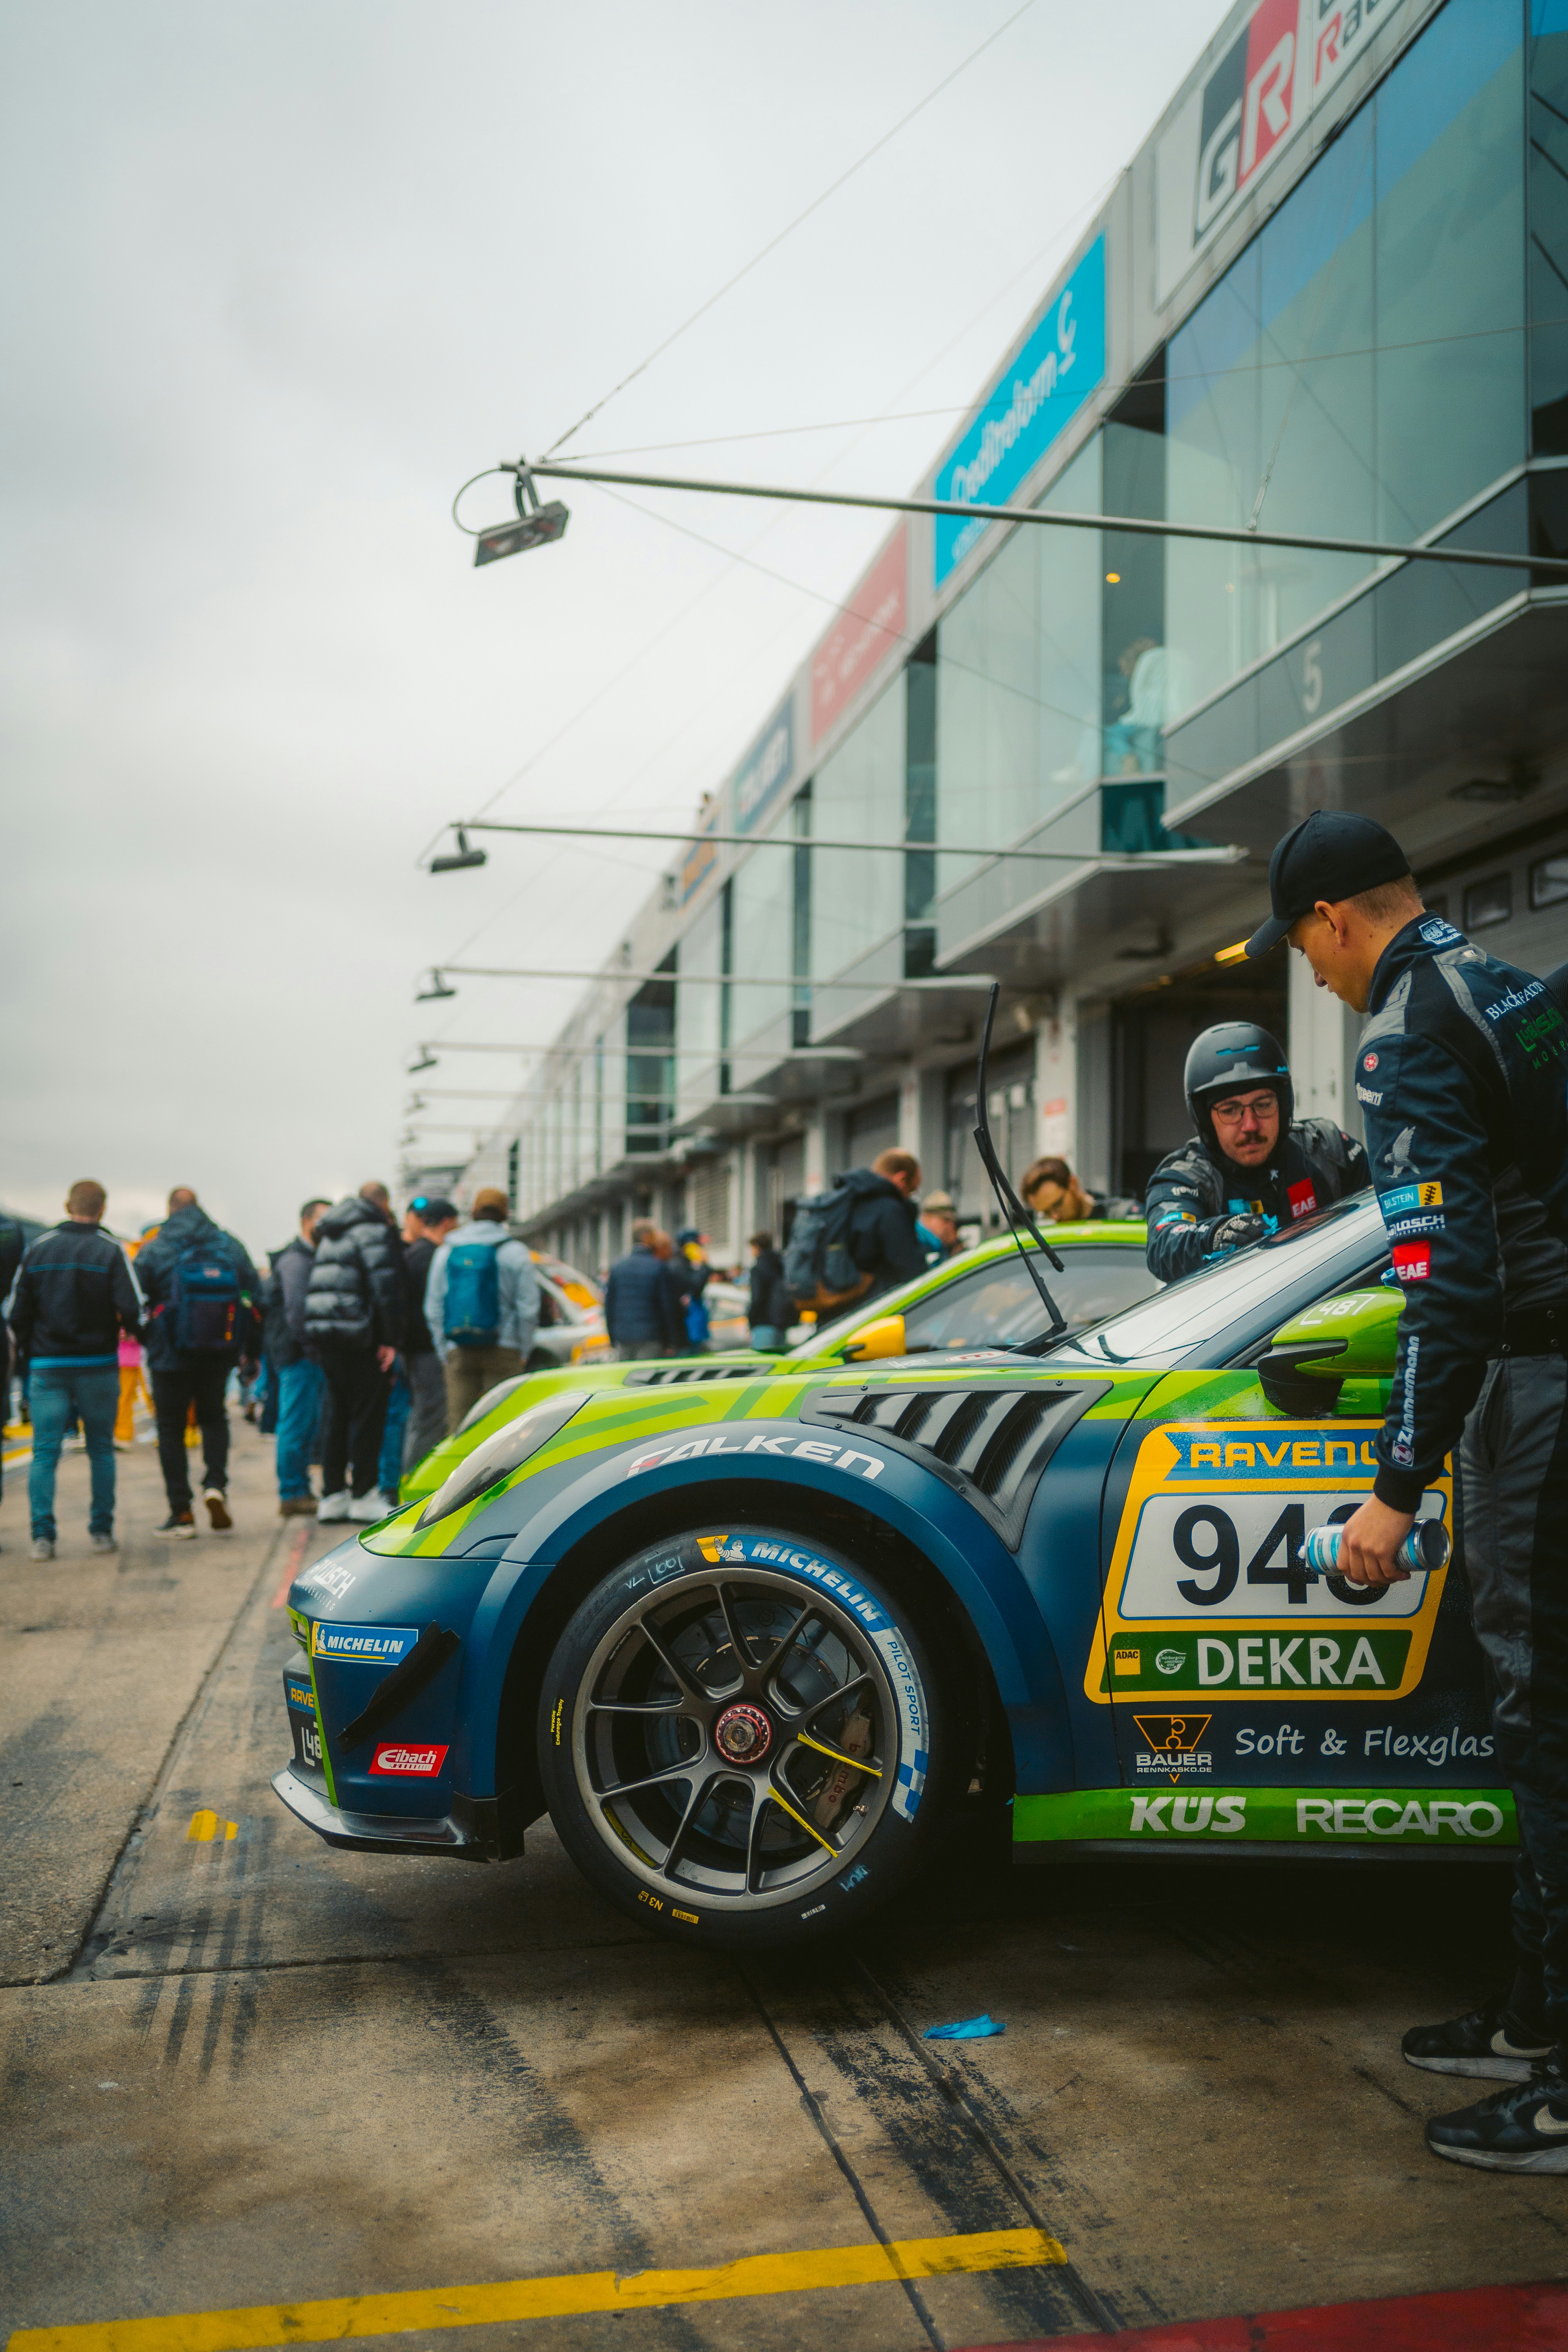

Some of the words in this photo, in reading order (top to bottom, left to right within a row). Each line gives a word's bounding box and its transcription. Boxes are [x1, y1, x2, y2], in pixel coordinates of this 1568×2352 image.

[1196, 31, 1296, 233] GR
[1302, 641, 1323, 713] 5
[1292, 1196, 1316, 1217] EAE
[1384, 1192, 1414, 1209] BILSTEIN
[1396, 1261, 1427, 1281] EAE
[1319, 1300, 1357, 1316] 48
[623, 1435, 885, 1480] FALKEN
[751, 1542, 882, 1622] MICHELIN
[327, 1635, 404, 1653] MICHELIN
[1116, 1651, 1139, 1659] ADAC
[1197, 1637, 1386, 1685] DEKRA
[887, 1641, 911, 1681] PILOT
[905, 1685, 920, 1736] SPORT
[377, 1749, 437, 1769] Eibach
[1136, 1754, 1212, 1766] BAUER
[1236, 1724, 1305, 1755] Soft
[1320, 1728, 1347, 1755] &
[1364, 1726, 1494, 1766] Flexglas
[1129, 1796, 1247, 1832] KÜS
[1296, 1798, 1504, 1837] RECARO
[649, 1897, 664, 1911] N3
